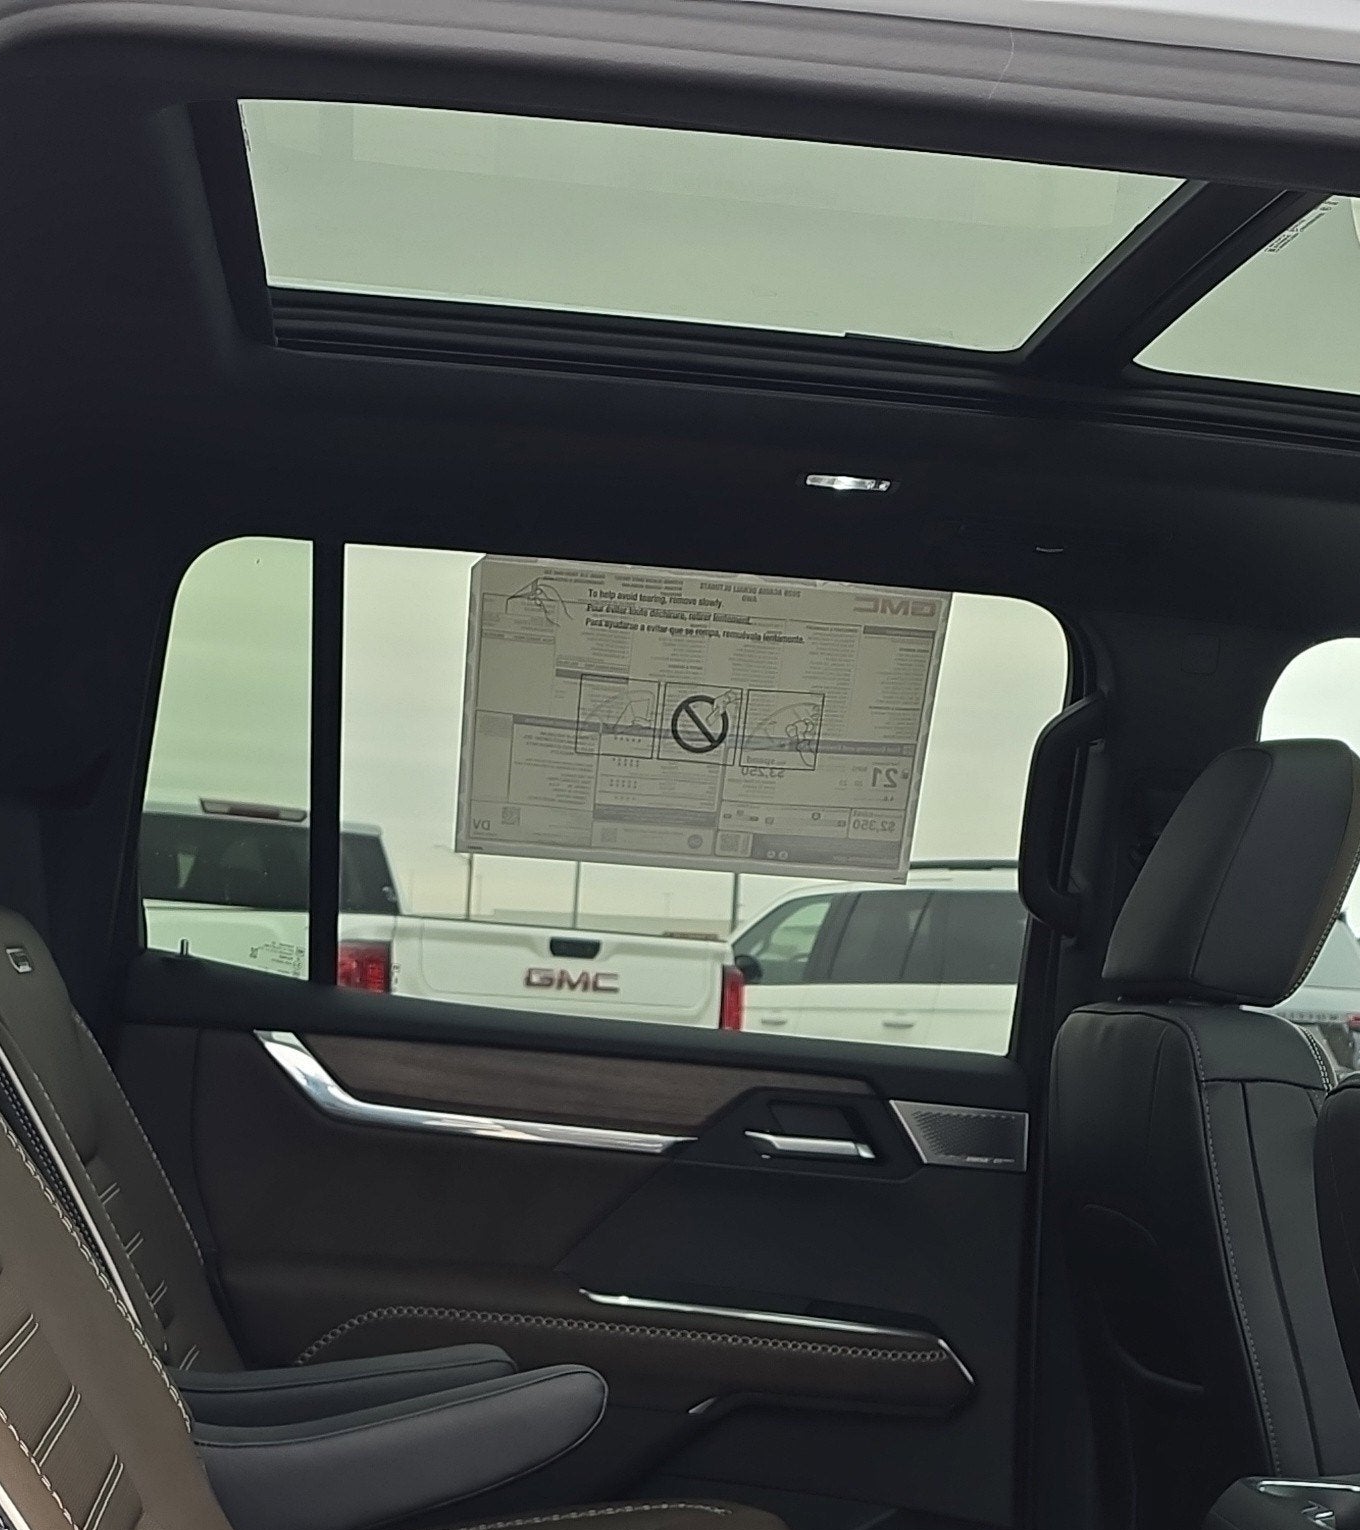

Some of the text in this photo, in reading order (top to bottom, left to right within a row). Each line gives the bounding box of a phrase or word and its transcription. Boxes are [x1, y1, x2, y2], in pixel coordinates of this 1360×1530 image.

[588, 589, 598, 598] To
[599, 590, 616, 600] help
[617, 592, 638, 602] avoid
[669, 597, 697, 606] remove
[585, 617, 603, 627] Para
[604, 619, 638, 631] ayudarse
[647, 623, 668, 633] evitar
[669, 626, 684, 636] que
[524, 967, 619, 993] GMC
